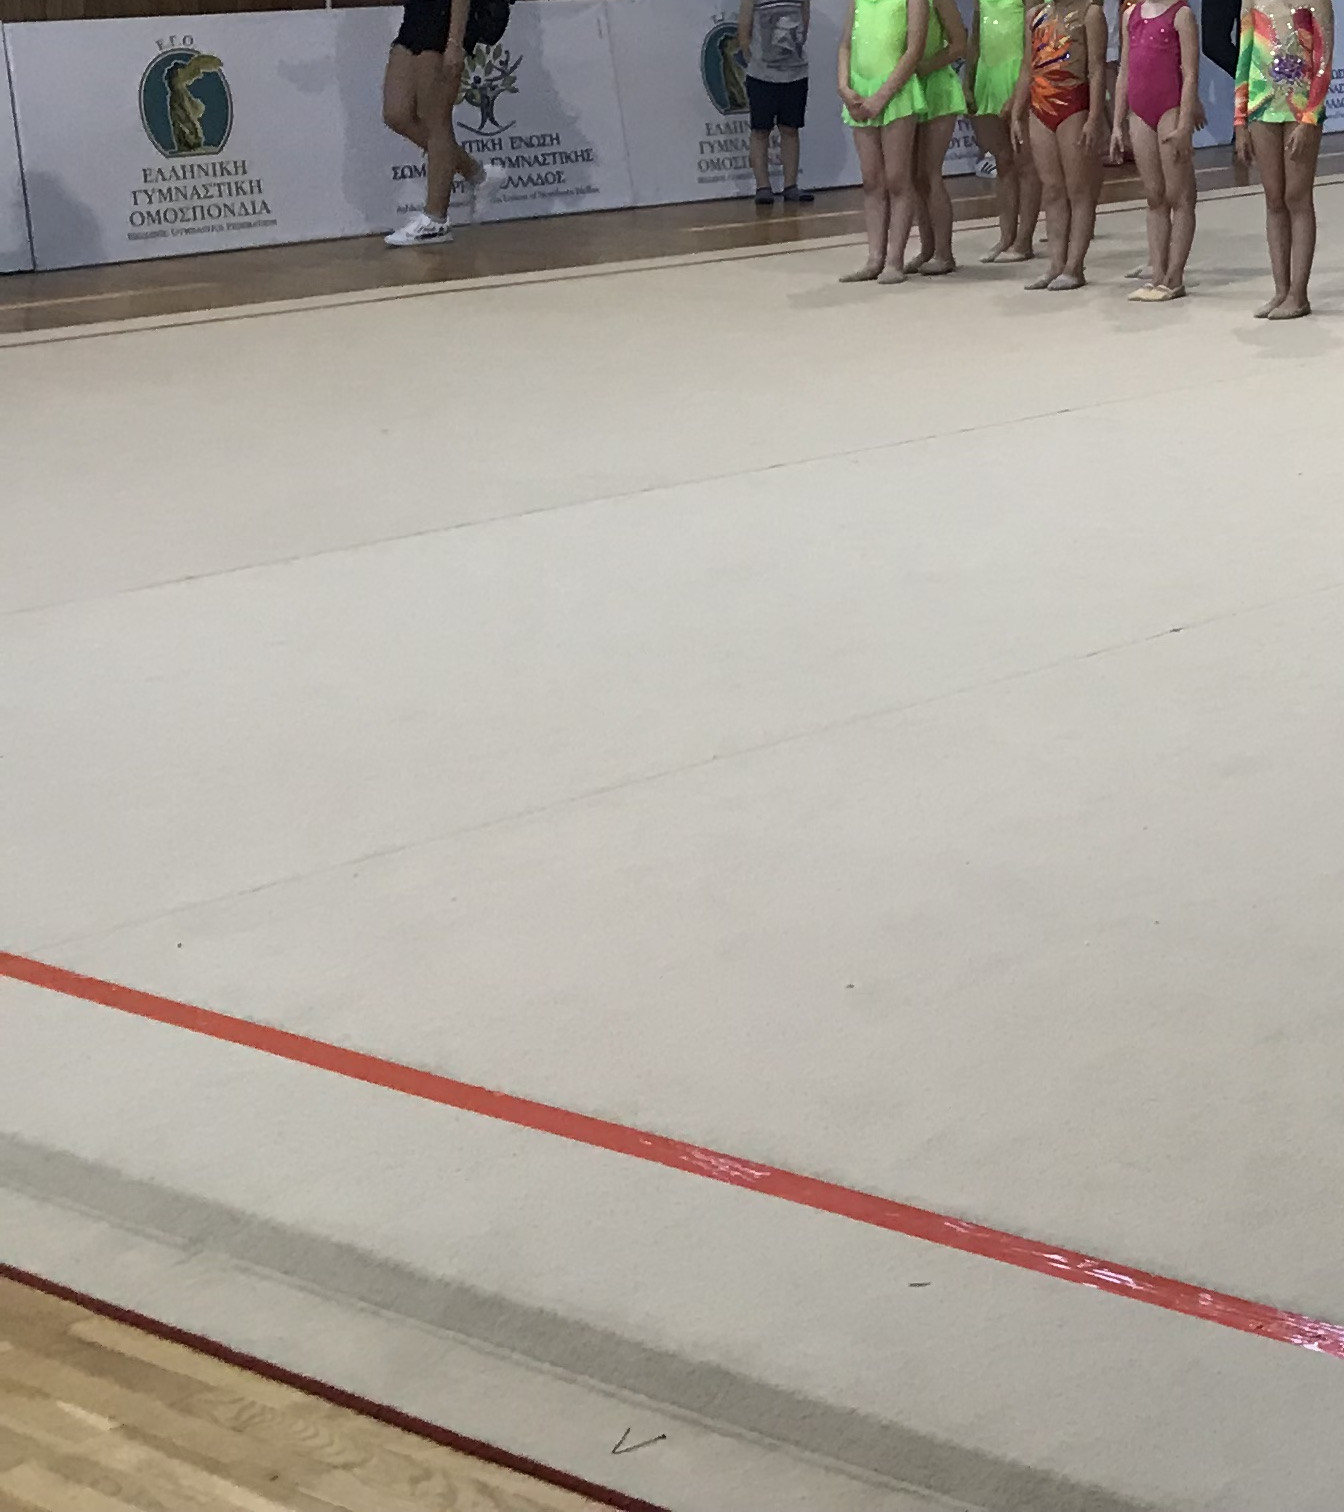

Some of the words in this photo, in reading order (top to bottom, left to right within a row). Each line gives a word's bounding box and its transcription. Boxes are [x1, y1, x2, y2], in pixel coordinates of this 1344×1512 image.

[509, 133, 560, 150] ΕΝΩΣΗ
[142, 160, 247, 183] ΕΛΛΗΝΙΚΗ
[131, 179, 263, 205] ΓΥΜΝΑΣΤΙΚΗ
[129, 199, 271, 227] ΟΜΟΣΠΟΝΔΙΑ
